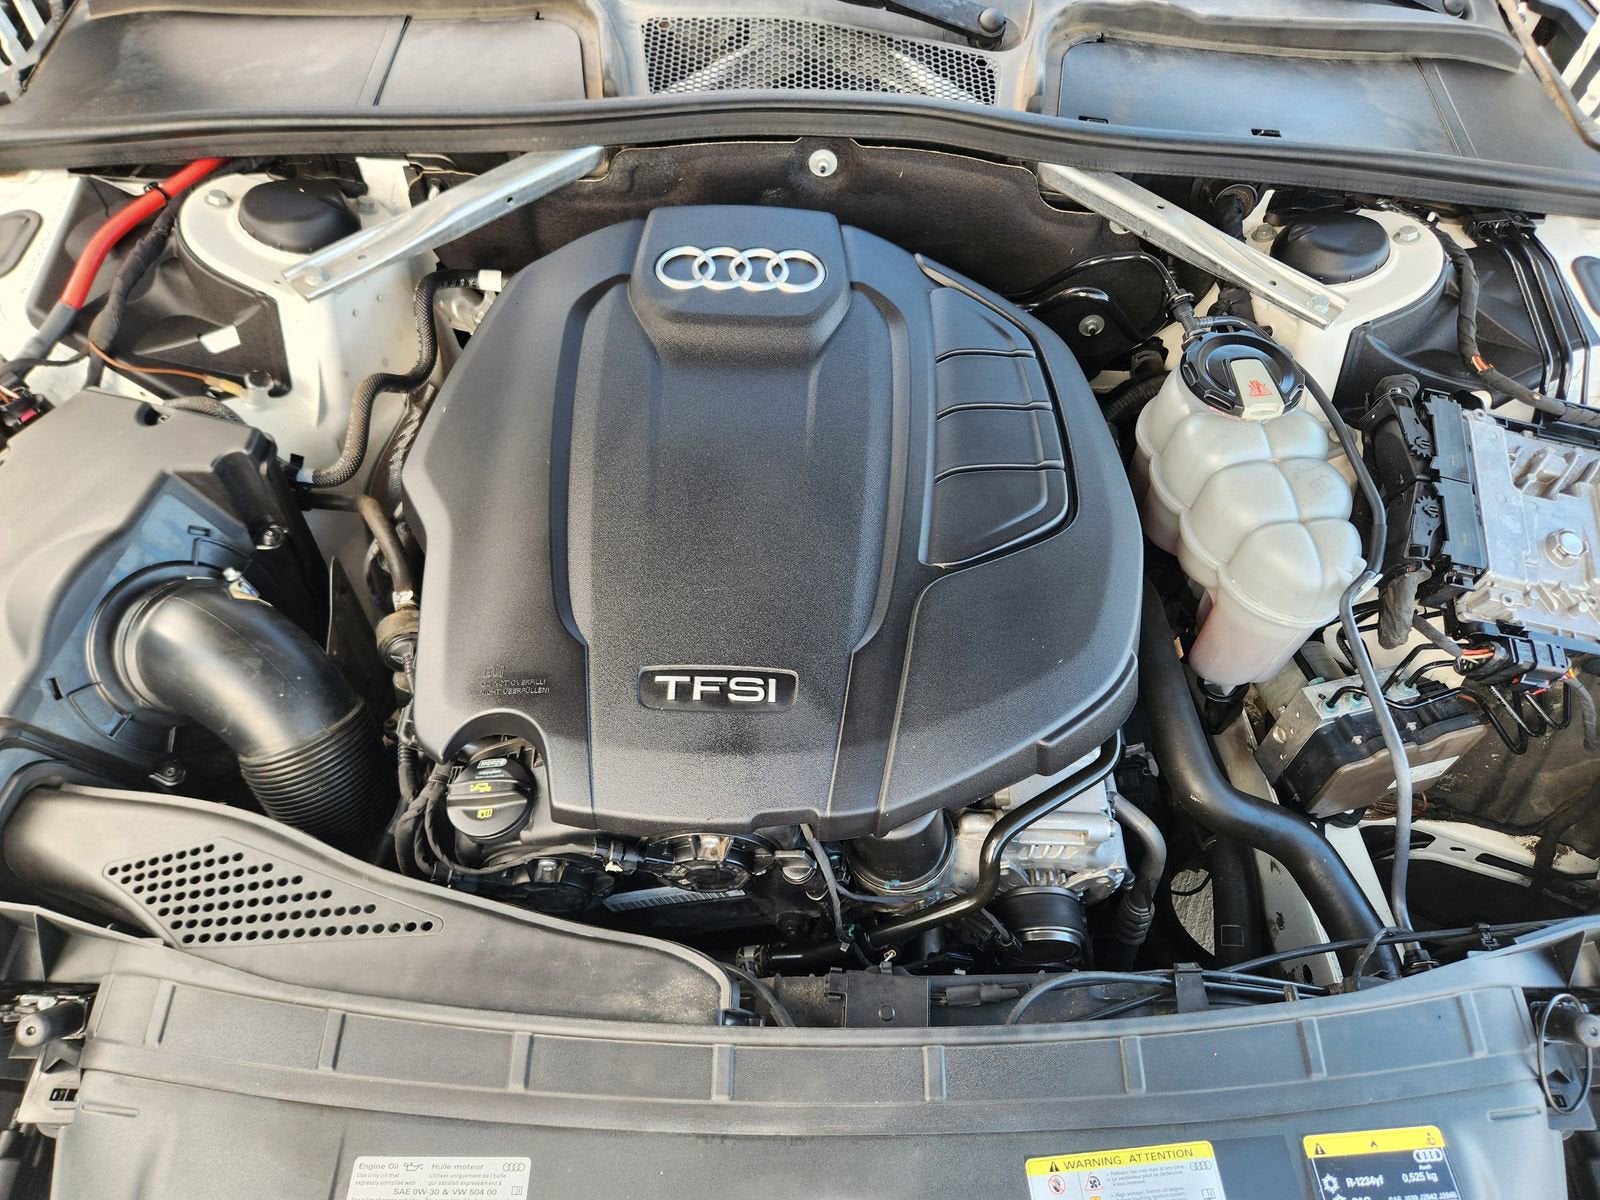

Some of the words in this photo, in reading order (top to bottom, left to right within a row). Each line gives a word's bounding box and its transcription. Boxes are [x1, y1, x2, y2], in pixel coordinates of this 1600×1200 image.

[654, 675, 777, 703] TFSI
[1063, 1155, 1122, 1170] WARNING
[1129, 1148, 1193, 1163] ATTENTION
[358, 1163, 386, 1171] Engine
[1345, 1174, 1384, 1188] R-1234yf
[1401, 1171, 1426, 1184] 0,525
[1425, 1170, 1439, 1183] kg
